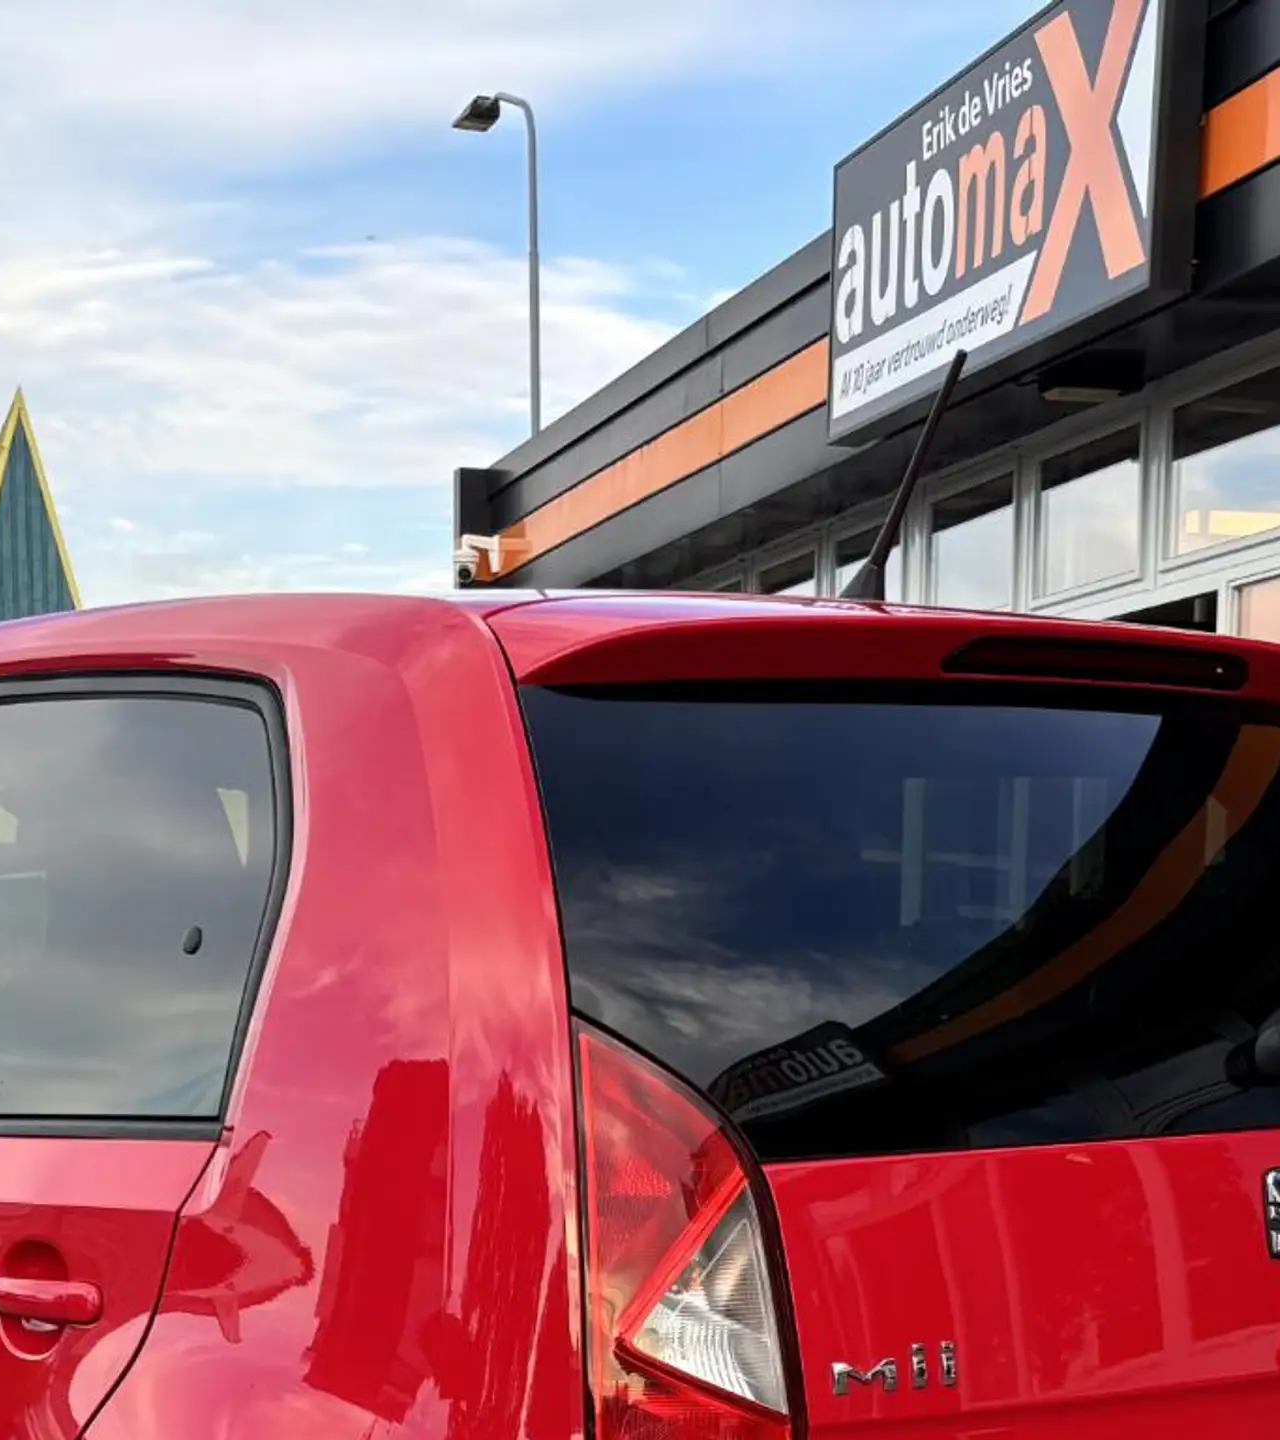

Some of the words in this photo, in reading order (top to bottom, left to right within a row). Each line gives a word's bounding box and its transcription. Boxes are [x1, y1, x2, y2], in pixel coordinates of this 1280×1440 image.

[922, 105, 956, 161] Erik
[958, 90, 981, 136] de
[983, 58, 1033, 116] Vries
[863, 355, 886, 395] jaar
[887, 319, 948, 377] vertrouwd
[946, 284, 1013, 345] onderweg!
[831, 1340, 957, 1396] Mii
